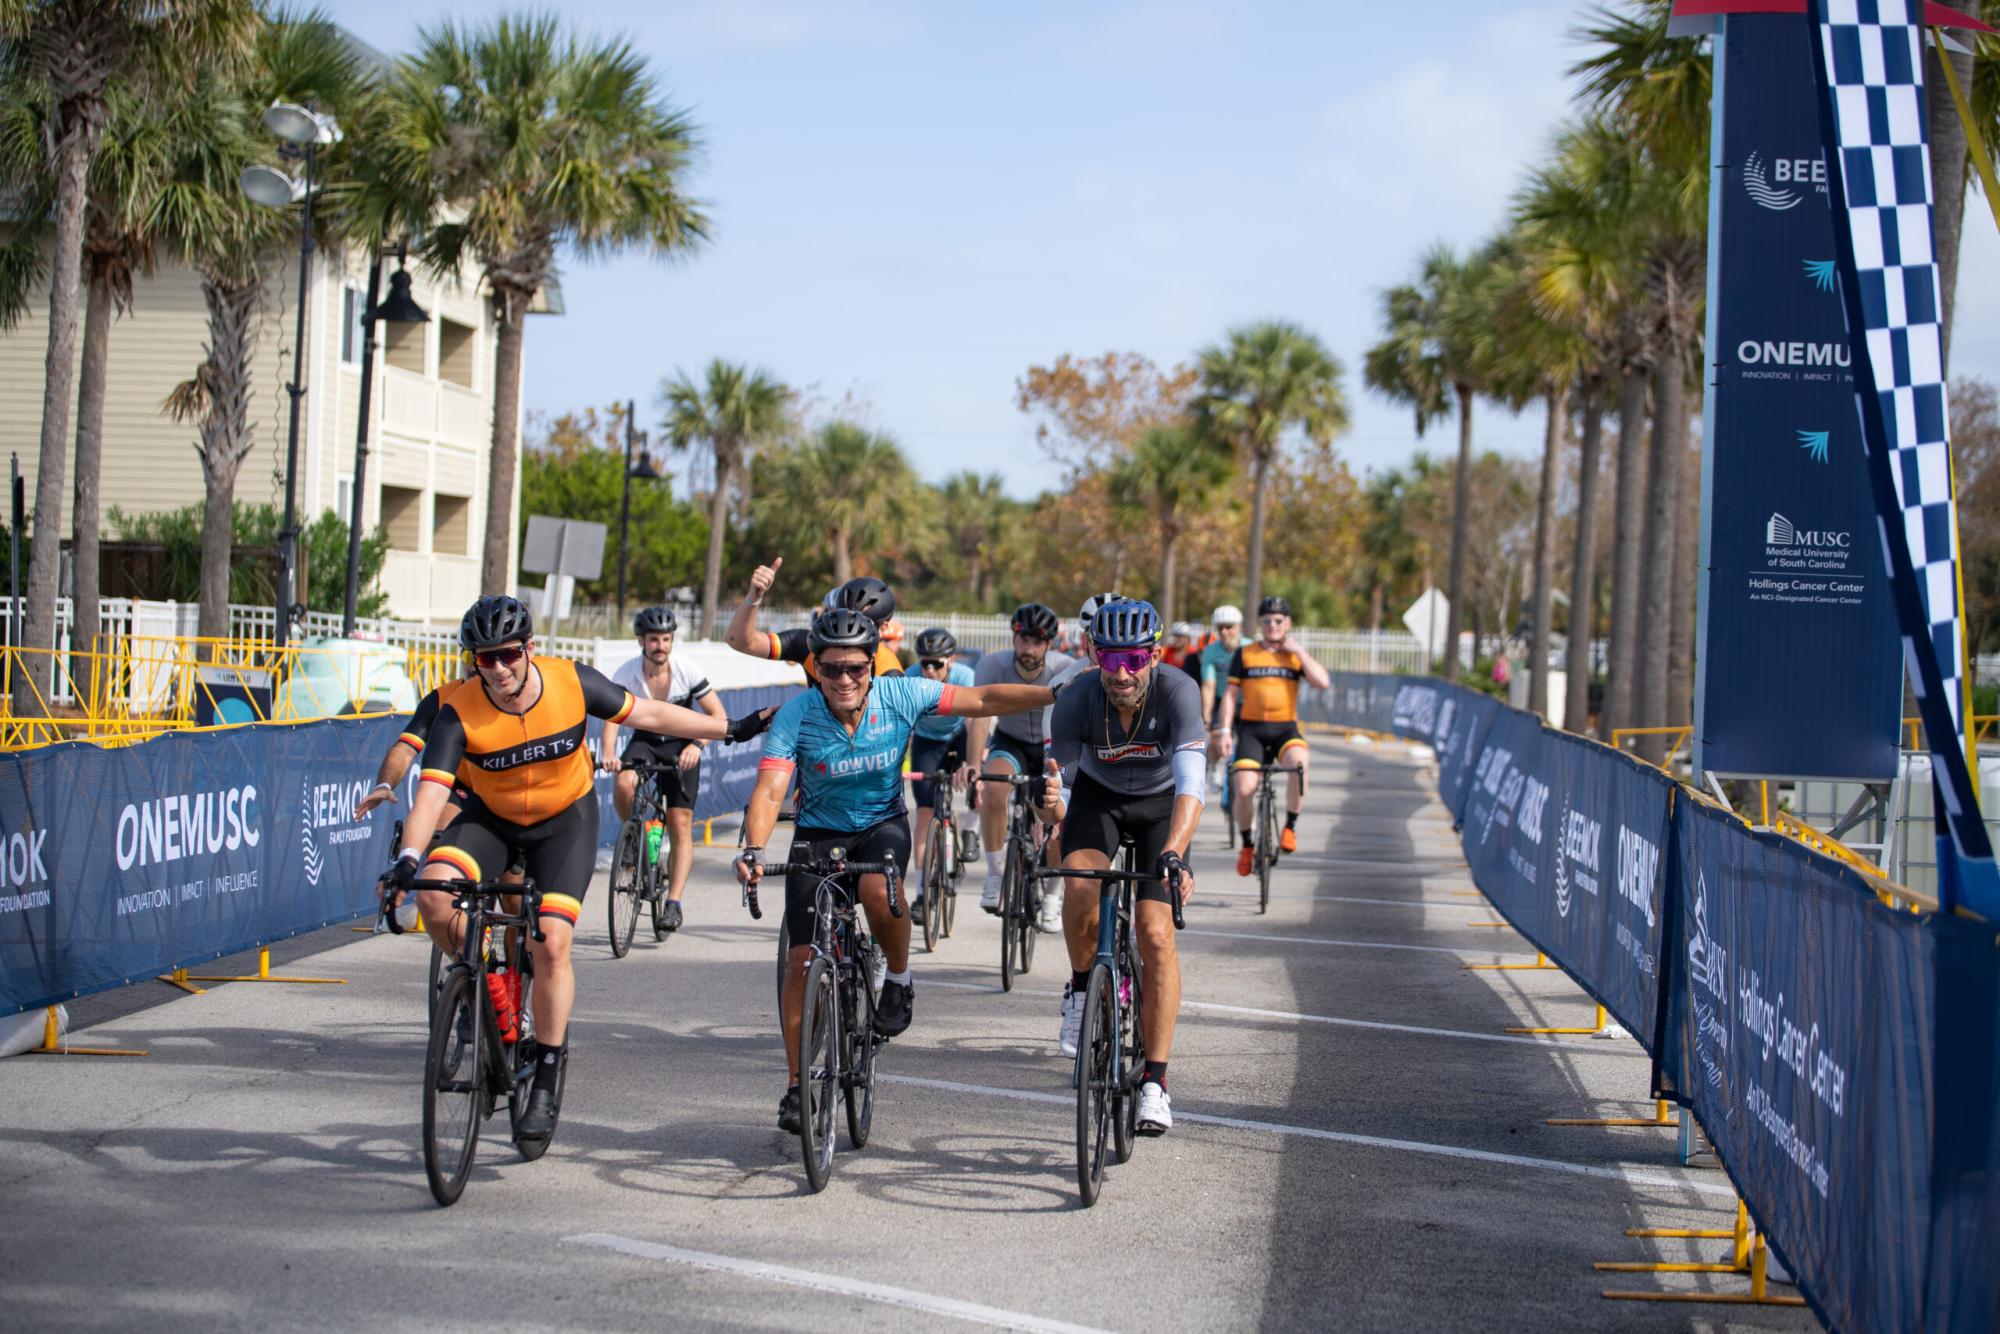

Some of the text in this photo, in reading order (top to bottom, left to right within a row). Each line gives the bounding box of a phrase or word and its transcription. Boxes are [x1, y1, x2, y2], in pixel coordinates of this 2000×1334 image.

[1737, 340, 1852, 367] ONEMU
[1742, 371, 1791, 380] INNOVATION
[1803, 373, 1832, 381] IMPACT
[1795, 531, 1850, 547] MUSC
[1766, 547, 1850, 560] Medical University
[1768, 558, 1845, 569] of South Carolina
[1749, 579, 1865, 592] Hollings Cancer Center
[482, 739, 575, 769] KILLER T's
[831, 747, 898, 775] LOWVELO
[116, 784, 260, 872] ONEMUSC
[0, 889, 50, 913] FOUNDATION
[117, 870, 258, 916] INNOVATION IMPACT INFLUENCE
[1738, 965, 1774, 1061] Hollings
[1776, 992, 1807, 1079] Cancer
[1809, 1022, 1845, 1117] Center
